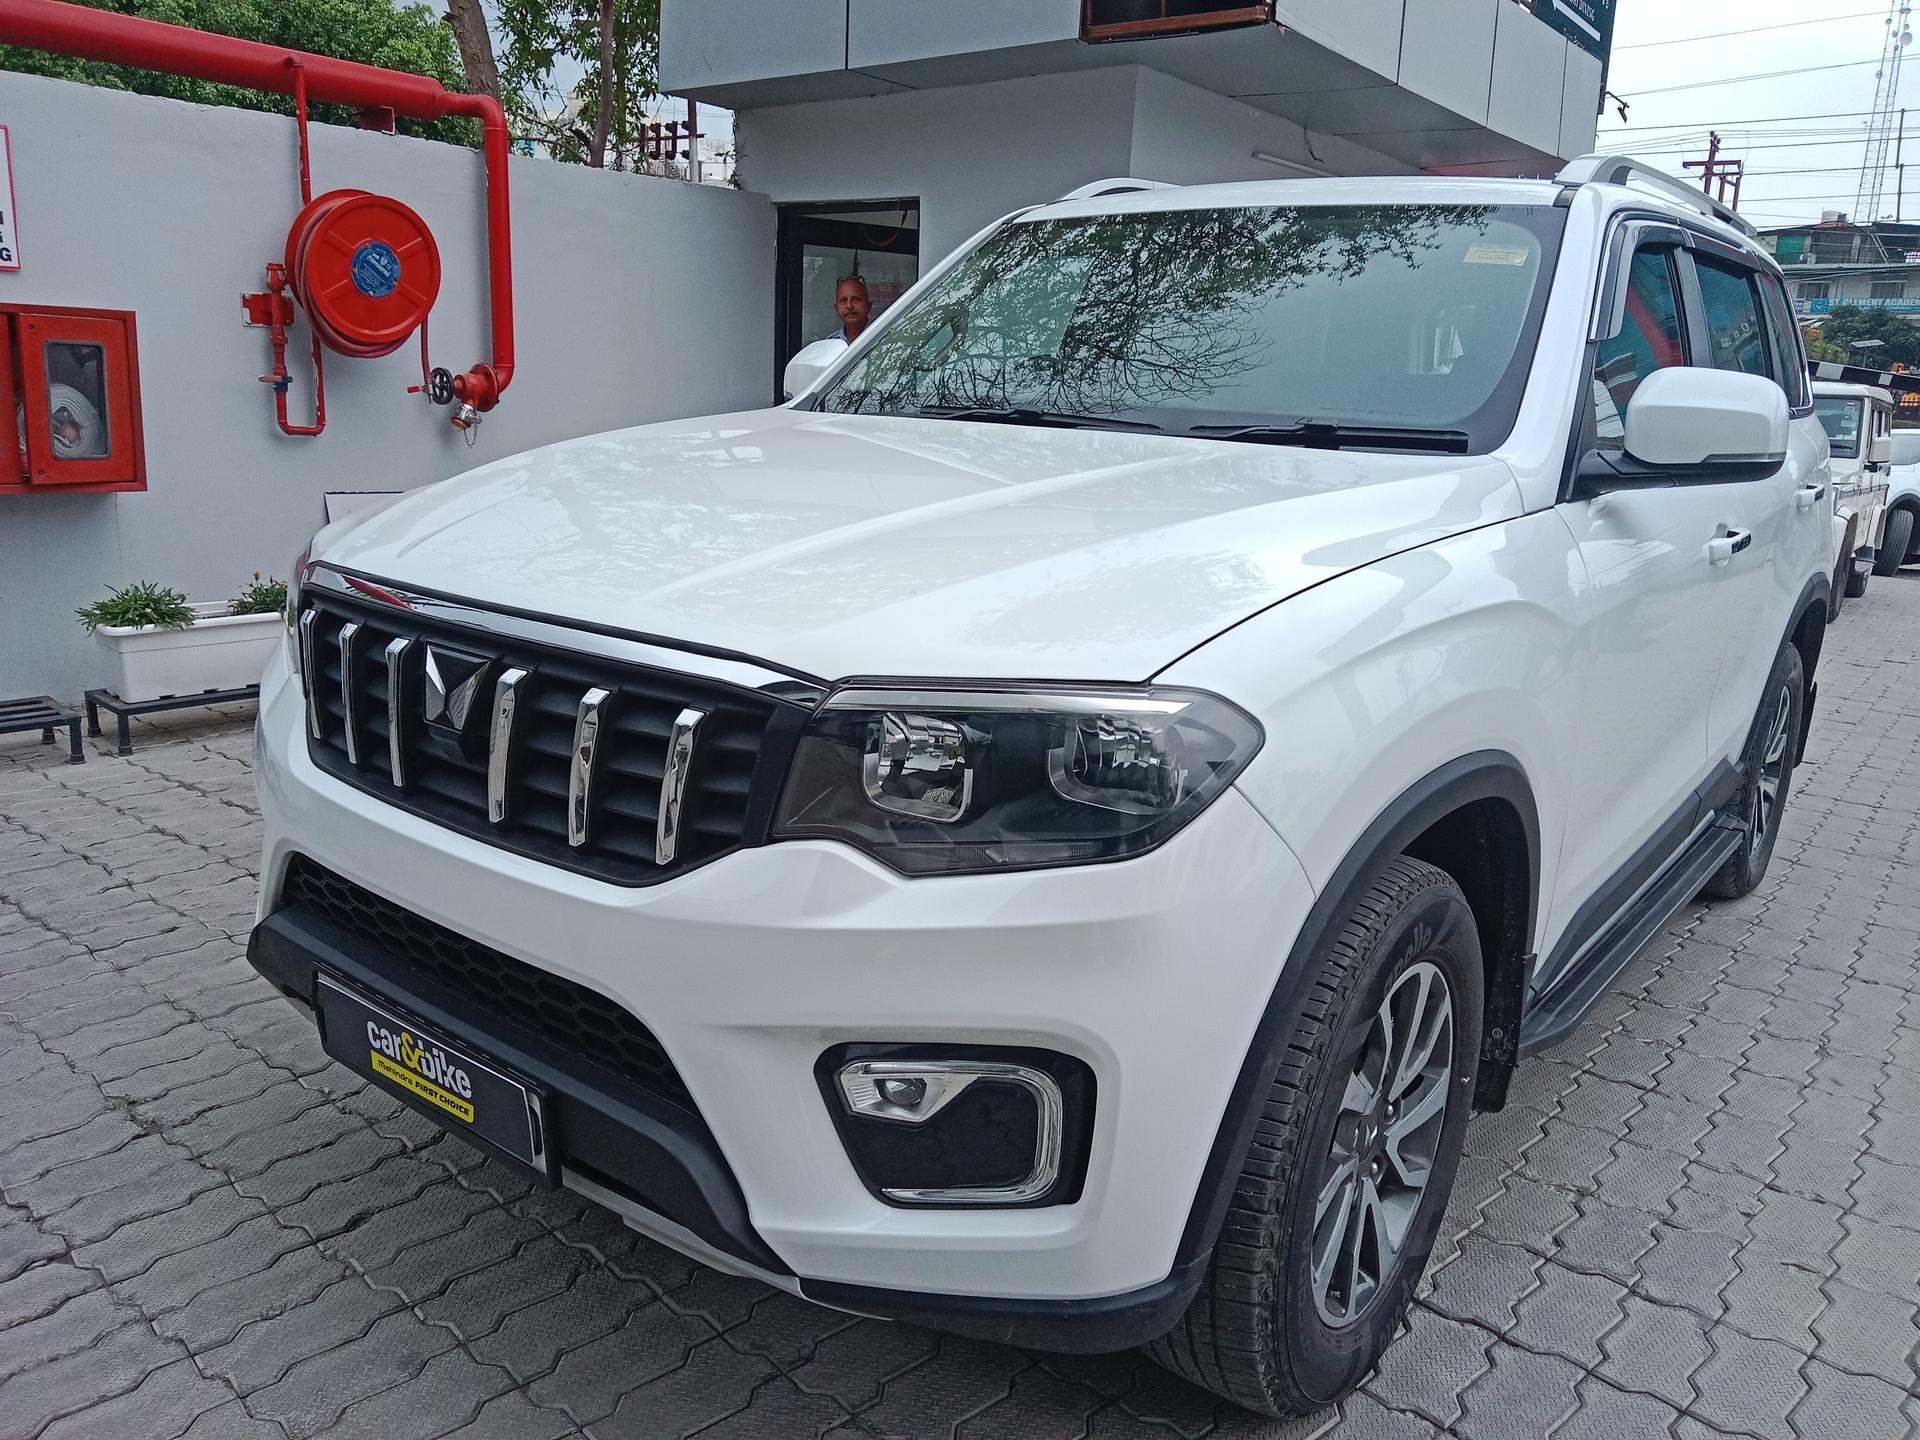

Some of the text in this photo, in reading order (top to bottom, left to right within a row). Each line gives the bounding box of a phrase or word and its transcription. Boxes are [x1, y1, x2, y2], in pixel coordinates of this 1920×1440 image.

[1384, 921, 1432, 999] apollo
[367, 1020, 472, 1099] car&bike
[378, 1060, 470, 1116] Mahindra FIRST CHOICE
